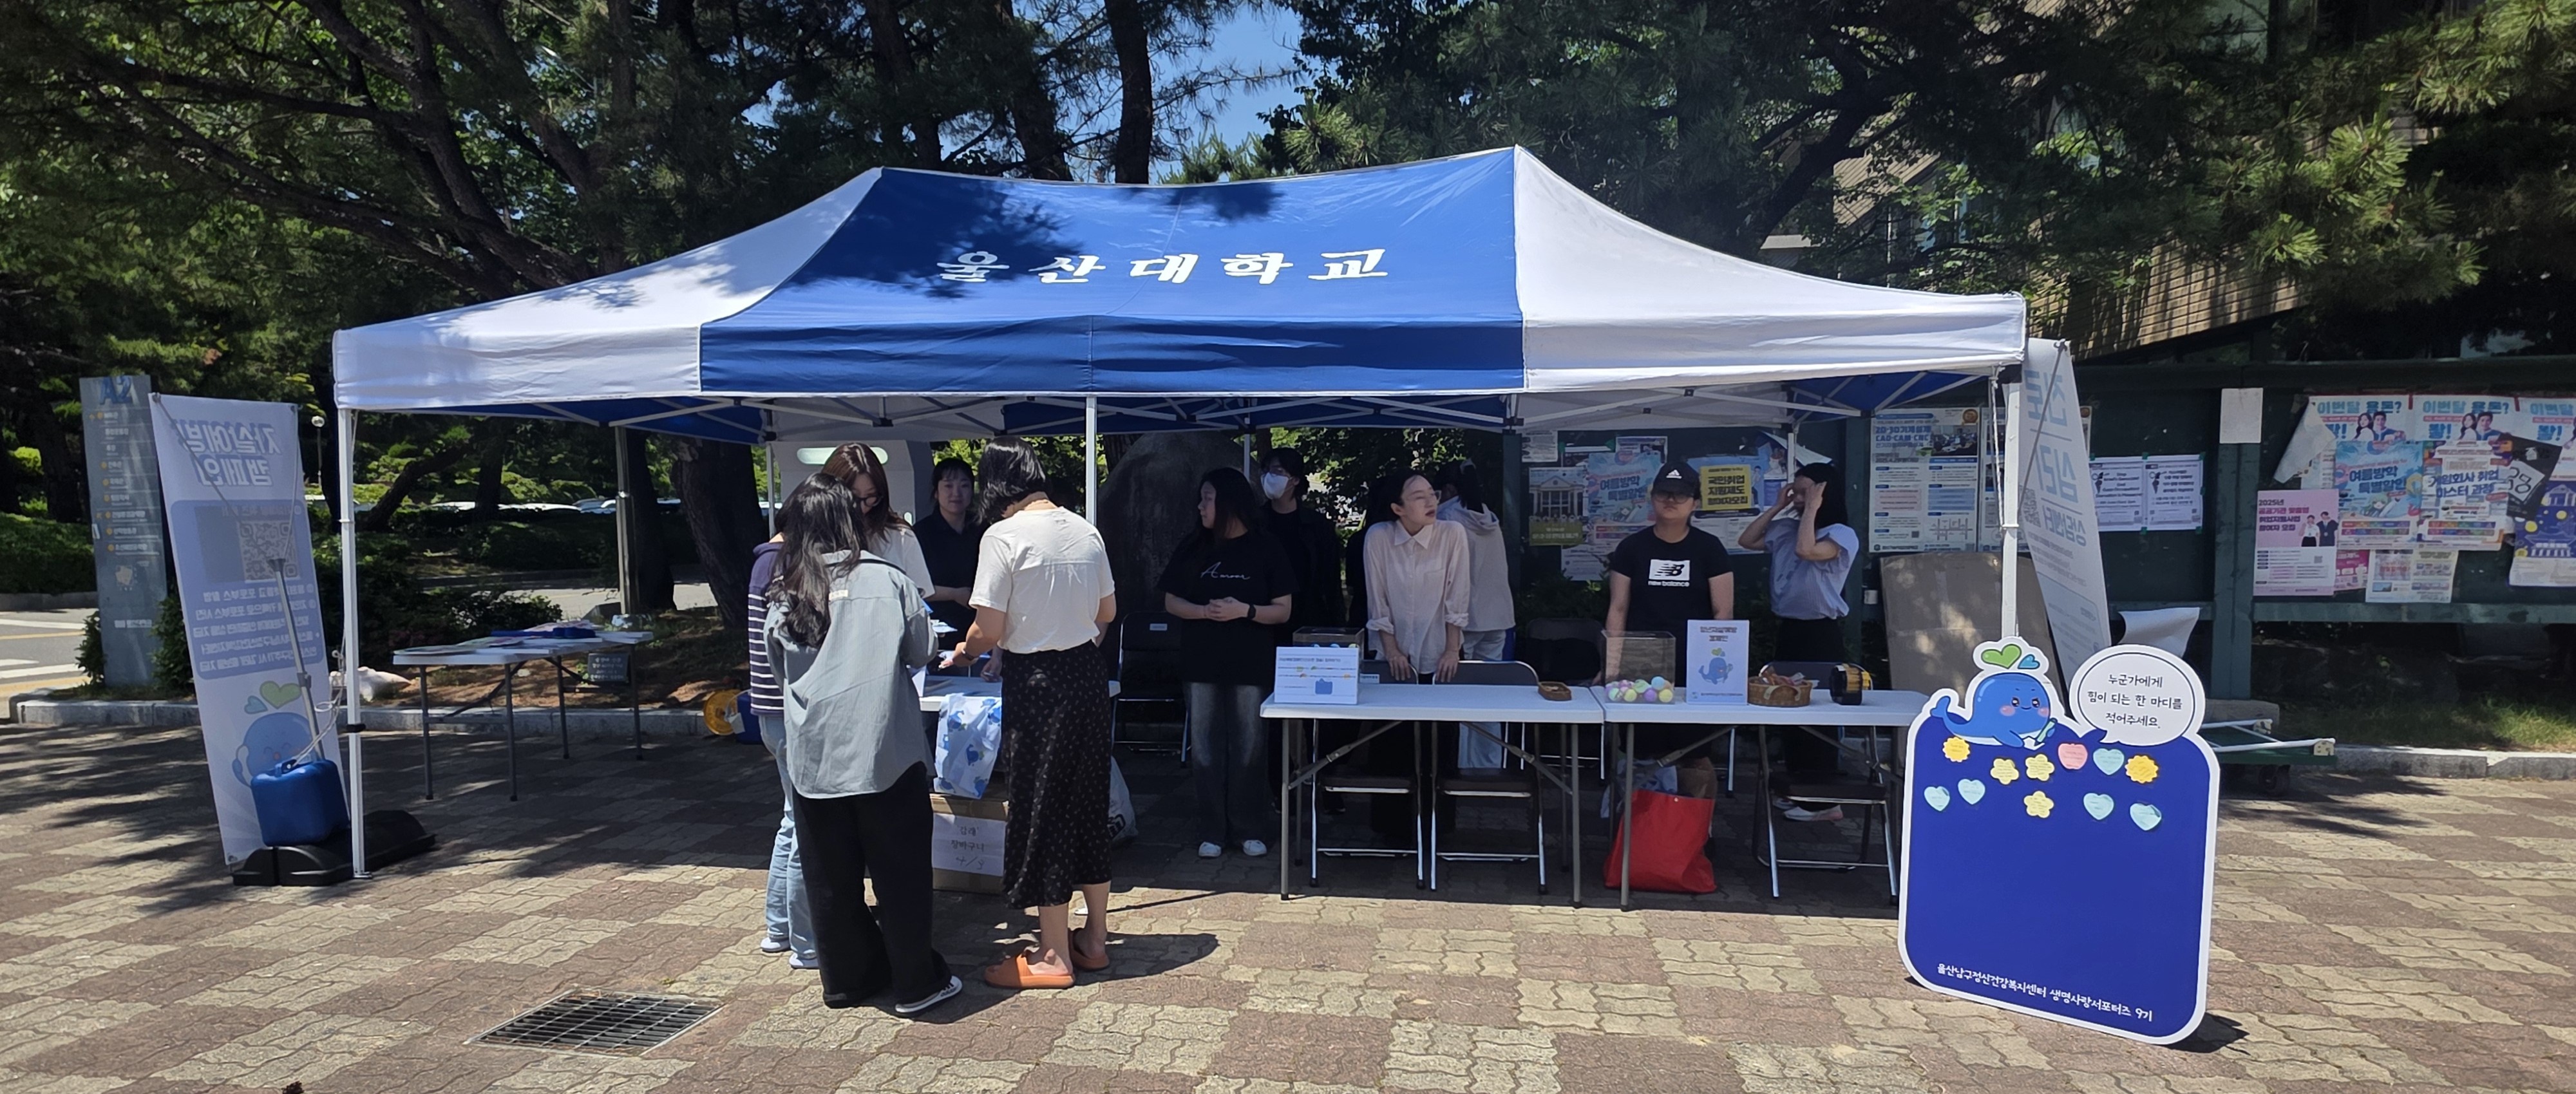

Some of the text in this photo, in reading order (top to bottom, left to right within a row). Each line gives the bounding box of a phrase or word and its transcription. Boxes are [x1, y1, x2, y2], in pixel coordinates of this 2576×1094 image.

[936, 249, 1388, 284] 울산대학교
[100, 375, 132, 405] A2
[2317, 401, 2360, 413] 이번달
[2423, 401, 2467, 413] 이번달
[2530, 403, 2573, 416] 이번달
[1707, 475, 1745, 484] 국민취업
[2349, 466, 2399, 482] 여름방학
[1600, 475, 1640, 490] 여름방학
[2358, 478, 2407, 493] 특별할인
[1707, 486, 1745, 495] 지원제도
[2436, 485, 2468, 498] 마스터
[1707, 496, 1748, 505] 참여자모집
[2108, 674, 2163, 688] 누군가에게
[2087, 691, 2183, 710] 힘이 되는 한 마디를
[2105, 712, 2161, 728] 적어주세요.
[1937, 963, 2152, 1022] 울산남구정신건강복지센터 생명사랑서포터즈 9기
